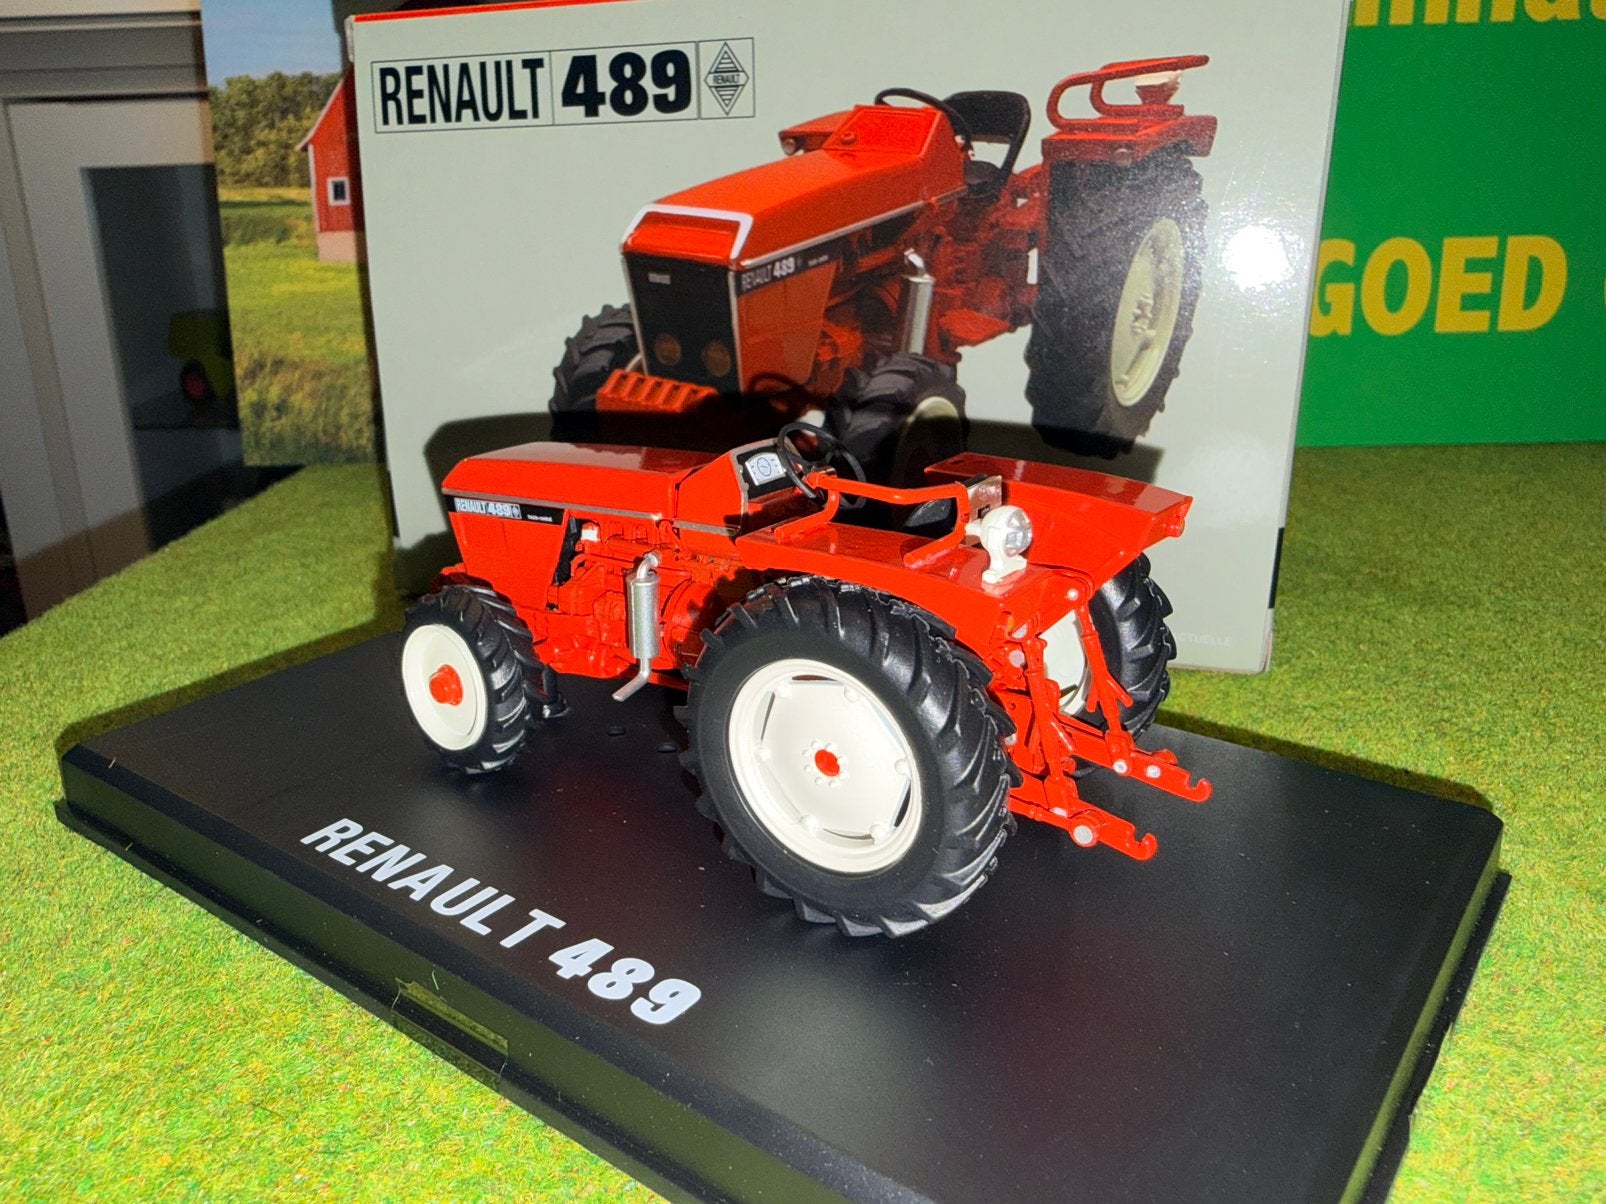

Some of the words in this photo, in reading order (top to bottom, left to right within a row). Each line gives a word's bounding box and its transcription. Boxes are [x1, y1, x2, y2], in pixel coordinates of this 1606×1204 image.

[378, 58, 545, 126] RENAULT
[561, 49, 692, 118] 489
[773, 256, 795, 278] 489
[1309, 235, 1568, 337] GOED
[455, 498, 486, 514] RENAULT
[488, 502, 511, 517] 489
[1178, 631, 1233, 648] CTUELLE
[300, 818, 567, 949] RENAULT
[548, 938, 702, 1025] 489
